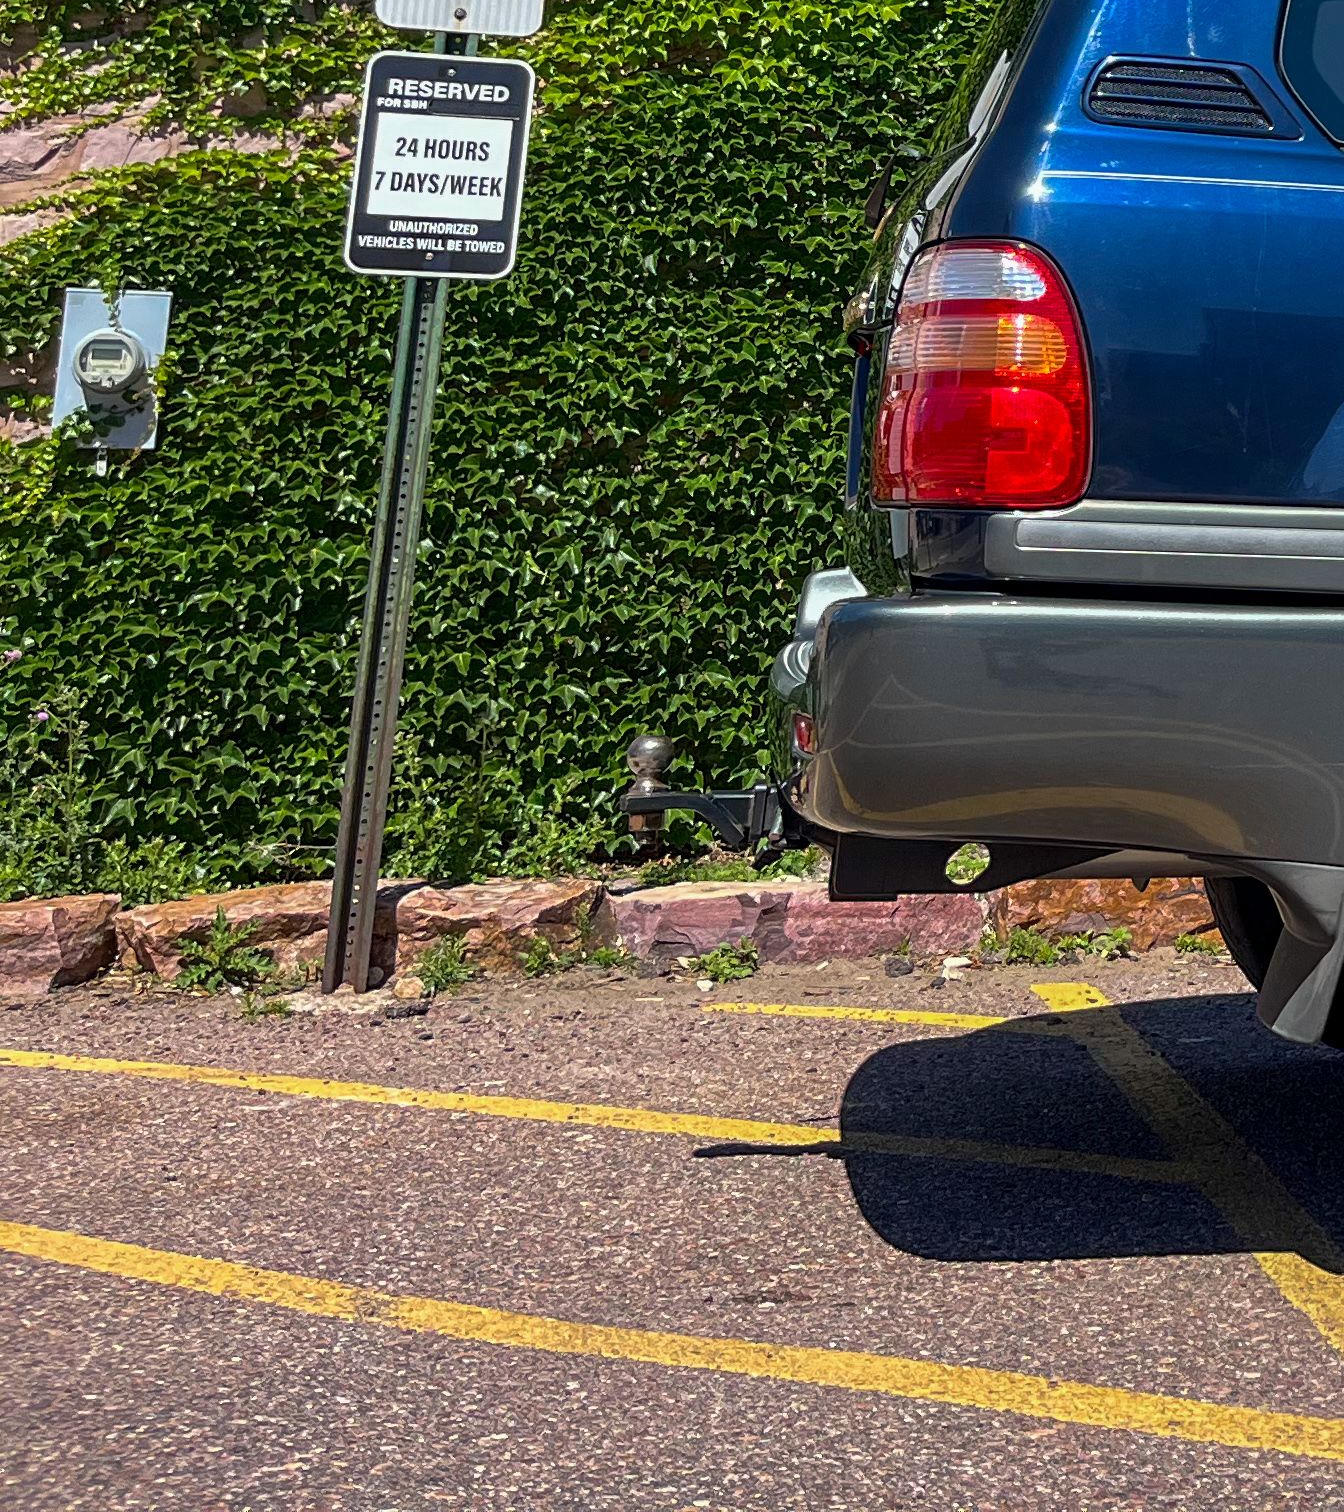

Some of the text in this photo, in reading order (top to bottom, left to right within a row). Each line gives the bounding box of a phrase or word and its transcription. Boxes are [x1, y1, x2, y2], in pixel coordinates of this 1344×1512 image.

[387, 78, 510, 102] RESERVED
[376, 96, 401, 108] FOR
[395, 137, 491, 162] 24 HOURS
[374, 171, 504, 197] 7 DAYS/WEEK
[389, 220, 479, 236] UNAUTHORIZED
[358, 235, 505, 254] VEHICLES WILL BE TOWED
